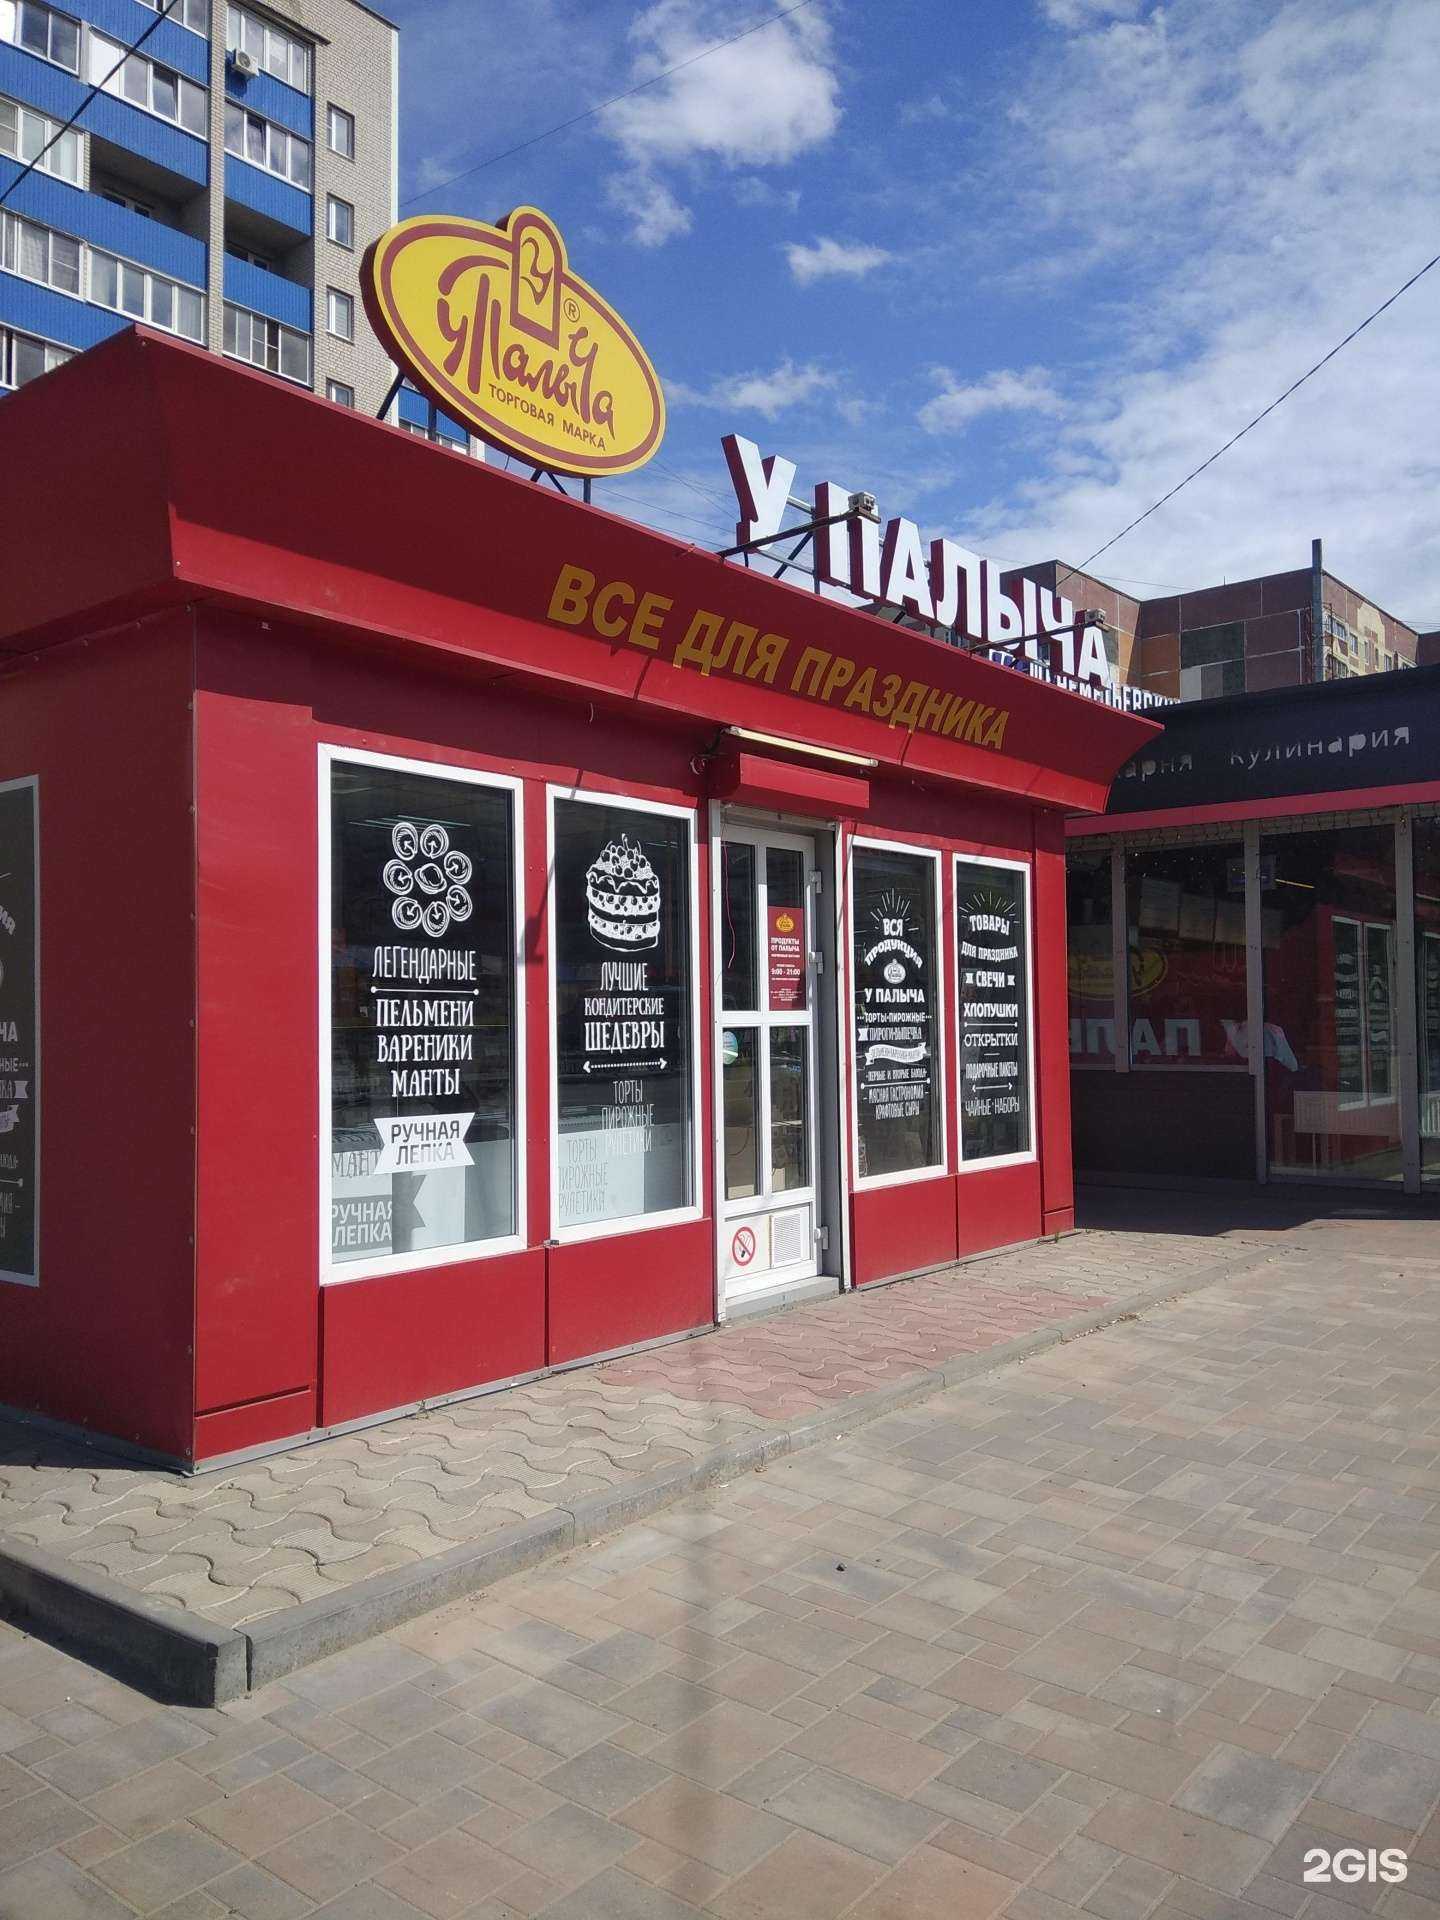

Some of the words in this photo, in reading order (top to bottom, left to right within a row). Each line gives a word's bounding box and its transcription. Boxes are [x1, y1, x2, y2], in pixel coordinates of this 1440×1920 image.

[489, 383, 555, 427] ТОРГОВАЯ
[562, 419, 606, 451] МАРКА
[721, 433, 797, 551] У
[814, 481, 1110, 692] ПАЛЫЧА
[547, 564, 674, 650] ВСЕ
[672, 609, 790, 685] ДЛЯ
[790, 646, 1009, 750] ПРАЗДНИКА
[1115, 753, 1193, 782] арня
[883, 918, 903, 936] ВСЯ
[969, 915, 1009, 935] ТОВАРЫ
[372, 946, 477, 984] ЛЕГЕНДАРНЫЕ
[864, 938, 923, 969] ПРОДУКЦИЯ
[961, 941, 976, 958] ДЛЯ
[978, 946, 1018, 962] ПРАЗДНИКА
[600, 962, 648, 991] ЛУЧШИЕ
[976, 971, 1005, 987] СВЕЧИ
[584, 997, 664, 1018] КОНДИТЕРСКИЕ
[864, 988, 872, 1003] У
[876, 988, 925, 1003] ПАЛЫЧА
[376, 999, 474, 1027] ПЕЛЬМЕНИ
[964, 1003, 1018, 1017] ХЛОПУШКИ
[377, 1034, 473, 1062] ВАРЕНИКИ
[584, 1021, 664, 1054] ШЕДЕВРЫ
[964, 1033, 1018, 1046] ОТКРЫТКИ
[391, 1068, 460, 1098] МАНТЫ
[613, 1079, 643, 1104] ТОРТЫ
[601, 1104, 655, 1131] ПИРОЖНЫЕ
[391, 1120, 459, 1143] РУЧНАЯ
[396, 1142, 454, 1165] ЛЕПКА
